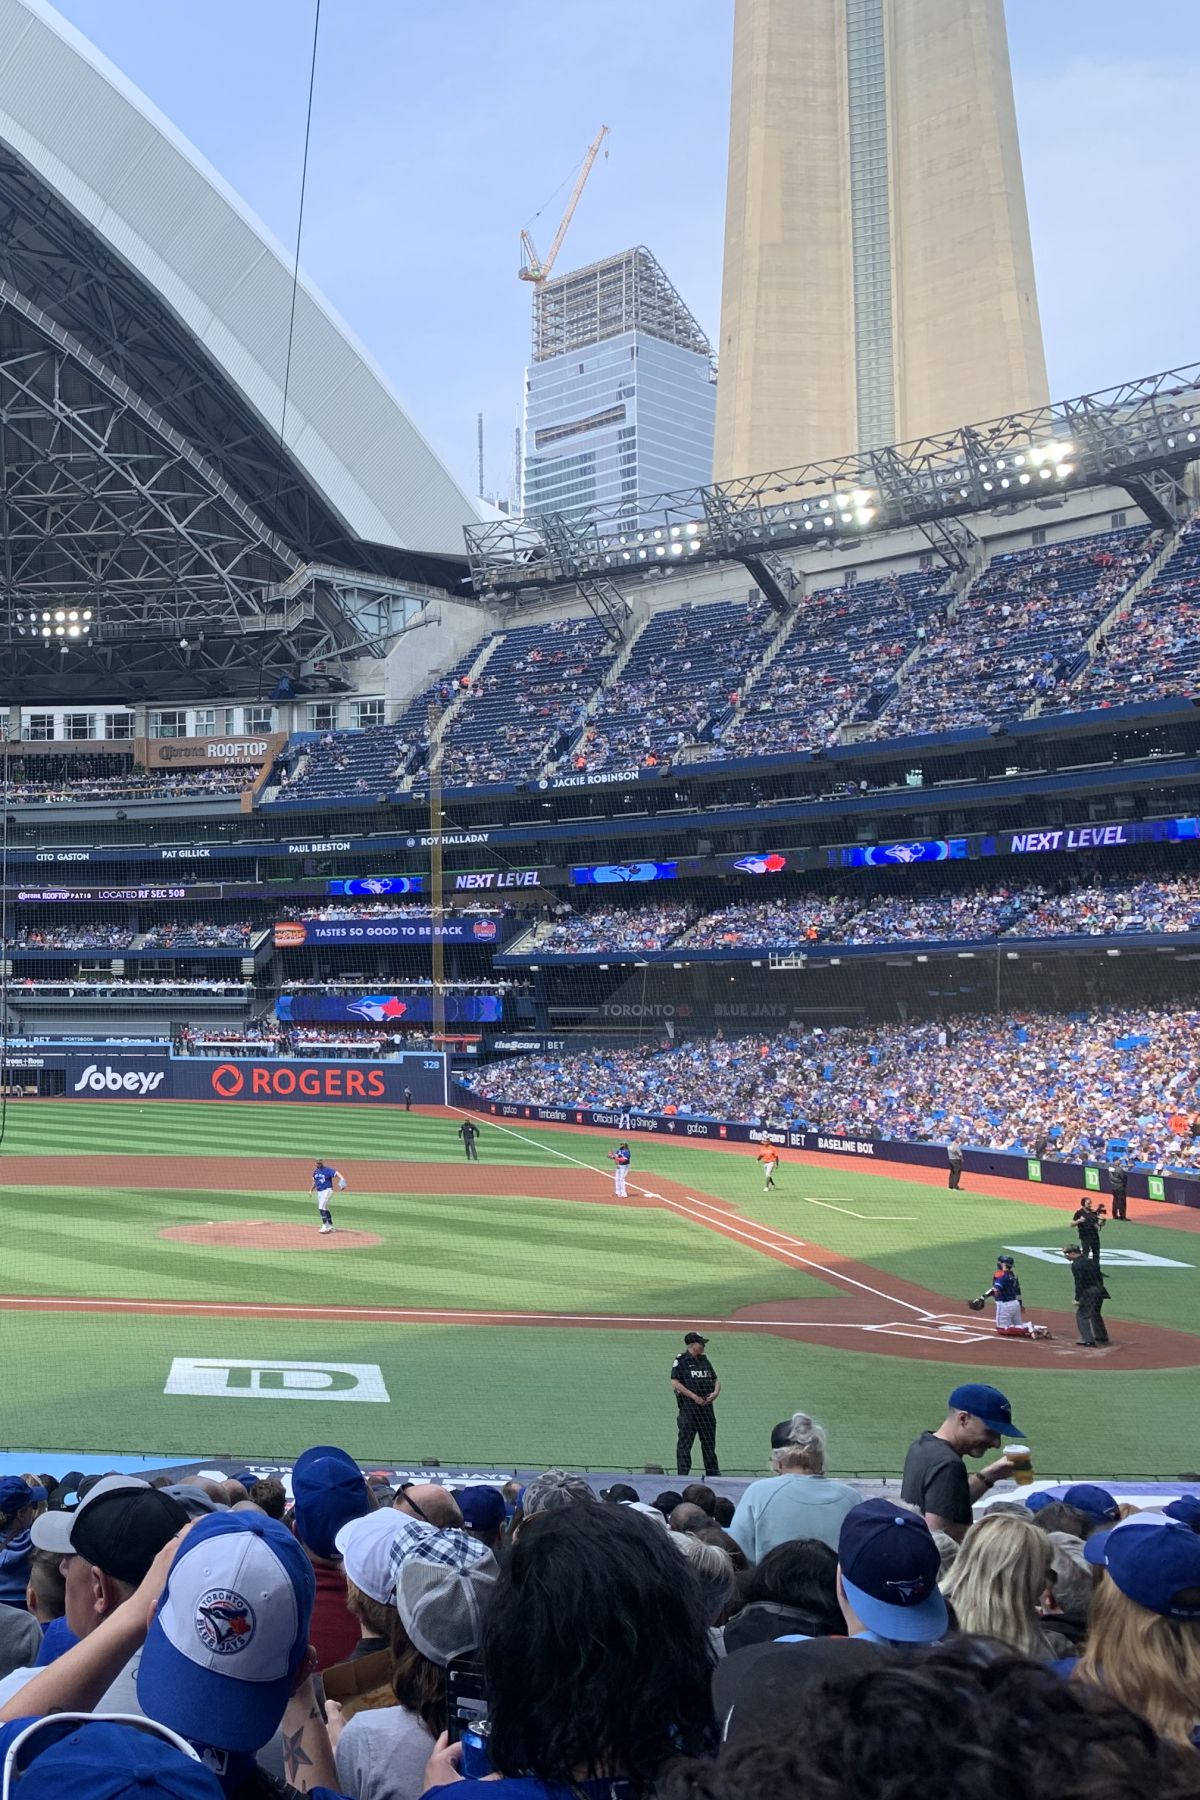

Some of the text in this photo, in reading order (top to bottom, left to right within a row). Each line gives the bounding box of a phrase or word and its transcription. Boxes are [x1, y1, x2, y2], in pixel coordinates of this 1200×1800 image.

[207, 742, 267, 758] ROOFTOP
[552, 777, 585, 788] JACKIE
[587, 771, 639, 785] ROBINSON
[421, 837, 439, 846] ROY
[441, 834, 489, 845] HALLADAY
[1011, 826, 1127, 853] NEXT LEVEL
[162, 849, 211, 858] PAT GILLICK
[288, 842, 350, 853] PAUL BEESTON
[36, 853, 90, 861] CITO GASTON
[455, 871, 541, 889] NEXT LEVEL
[18, 892, 41, 900] Corona
[42, 891, 70, 900] ROOFTOP
[98, 891, 137, 899] LOCATED
[138, 890, 149, 898] RF
[150, 890, 167, 898] SEC
[168, 889, 185, 898] 508
[315, 928, 347, 938] TASTES
[350, 927, 364, 937] SO
[366, 927, 399, 937] GOOD
[401, 926, 416, 936] TO
[419, 926, 433, 936] BE
[434, 925, 463, 936] BACK
[601, 1003, 787, 1017] TORONTO BLUE JAYS
[494, 1040, 565, 1050] theScore BET
[423, 1060, 440, 1069] 328
[75, 1064, 164, 1094] Sobeys
[252, 1068, 386, 1097] ROGERS
[538, 1108, 567, 1121] Timberline
[592, 1113, 613, 1124] Official
[635, 1116, 658, 1129] Shingle
[791, 1133, 806, 1147] BET
[818, 1138, 858, 1153] BASELINE
[858, 1143, 874, 1154] BOX
[1029, 1163, 1040, 1178] TD
[1086, 1171, 1098, 1186] TD
[1150, 1181, 1163, 1196] TD
[194, 1365, 359, 1392] TD
[396, 1470, 450, 1479] BLUE
[456, 1472, 513, 1481] JAYS
[201, 1592, 244, 1608] TORONTO
[196, 1619, 246, 1651] BLUE JAYS
